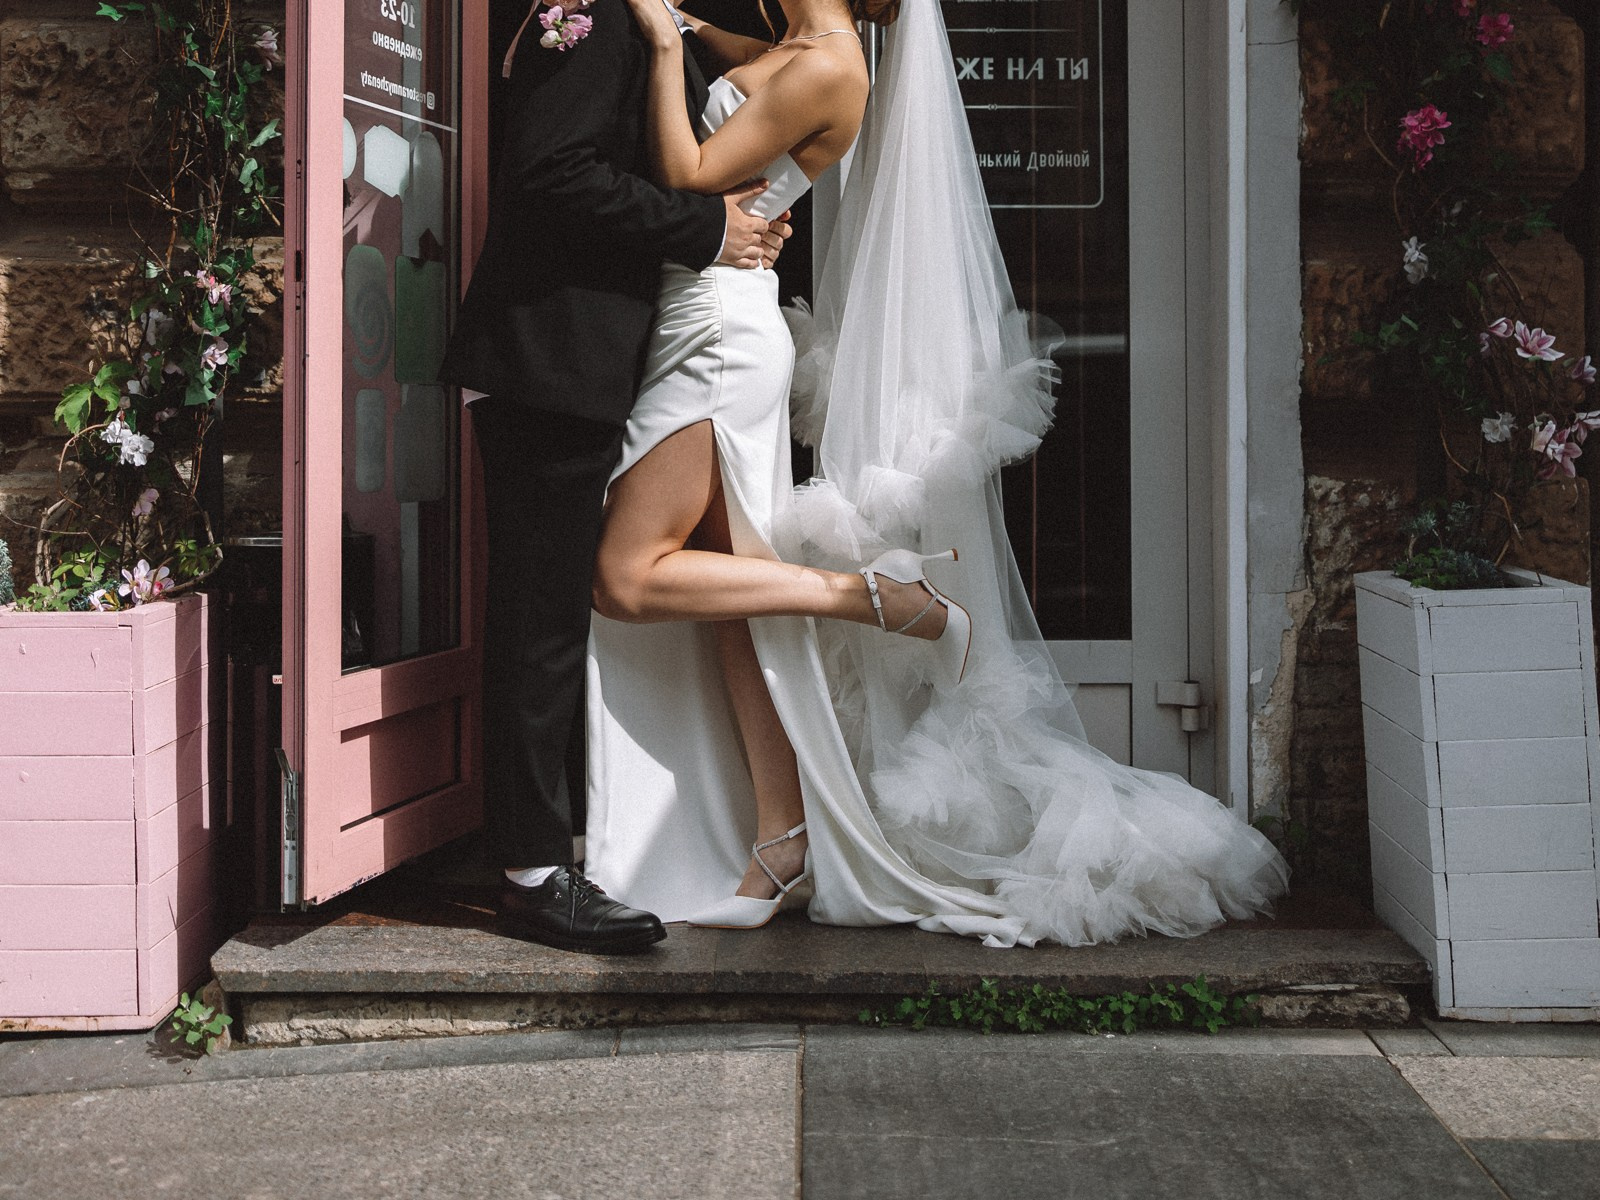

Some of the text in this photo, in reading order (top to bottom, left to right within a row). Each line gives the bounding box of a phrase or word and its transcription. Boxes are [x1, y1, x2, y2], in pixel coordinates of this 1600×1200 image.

[956, 57, 1089, 80] ЖЕ НА ТЫ
